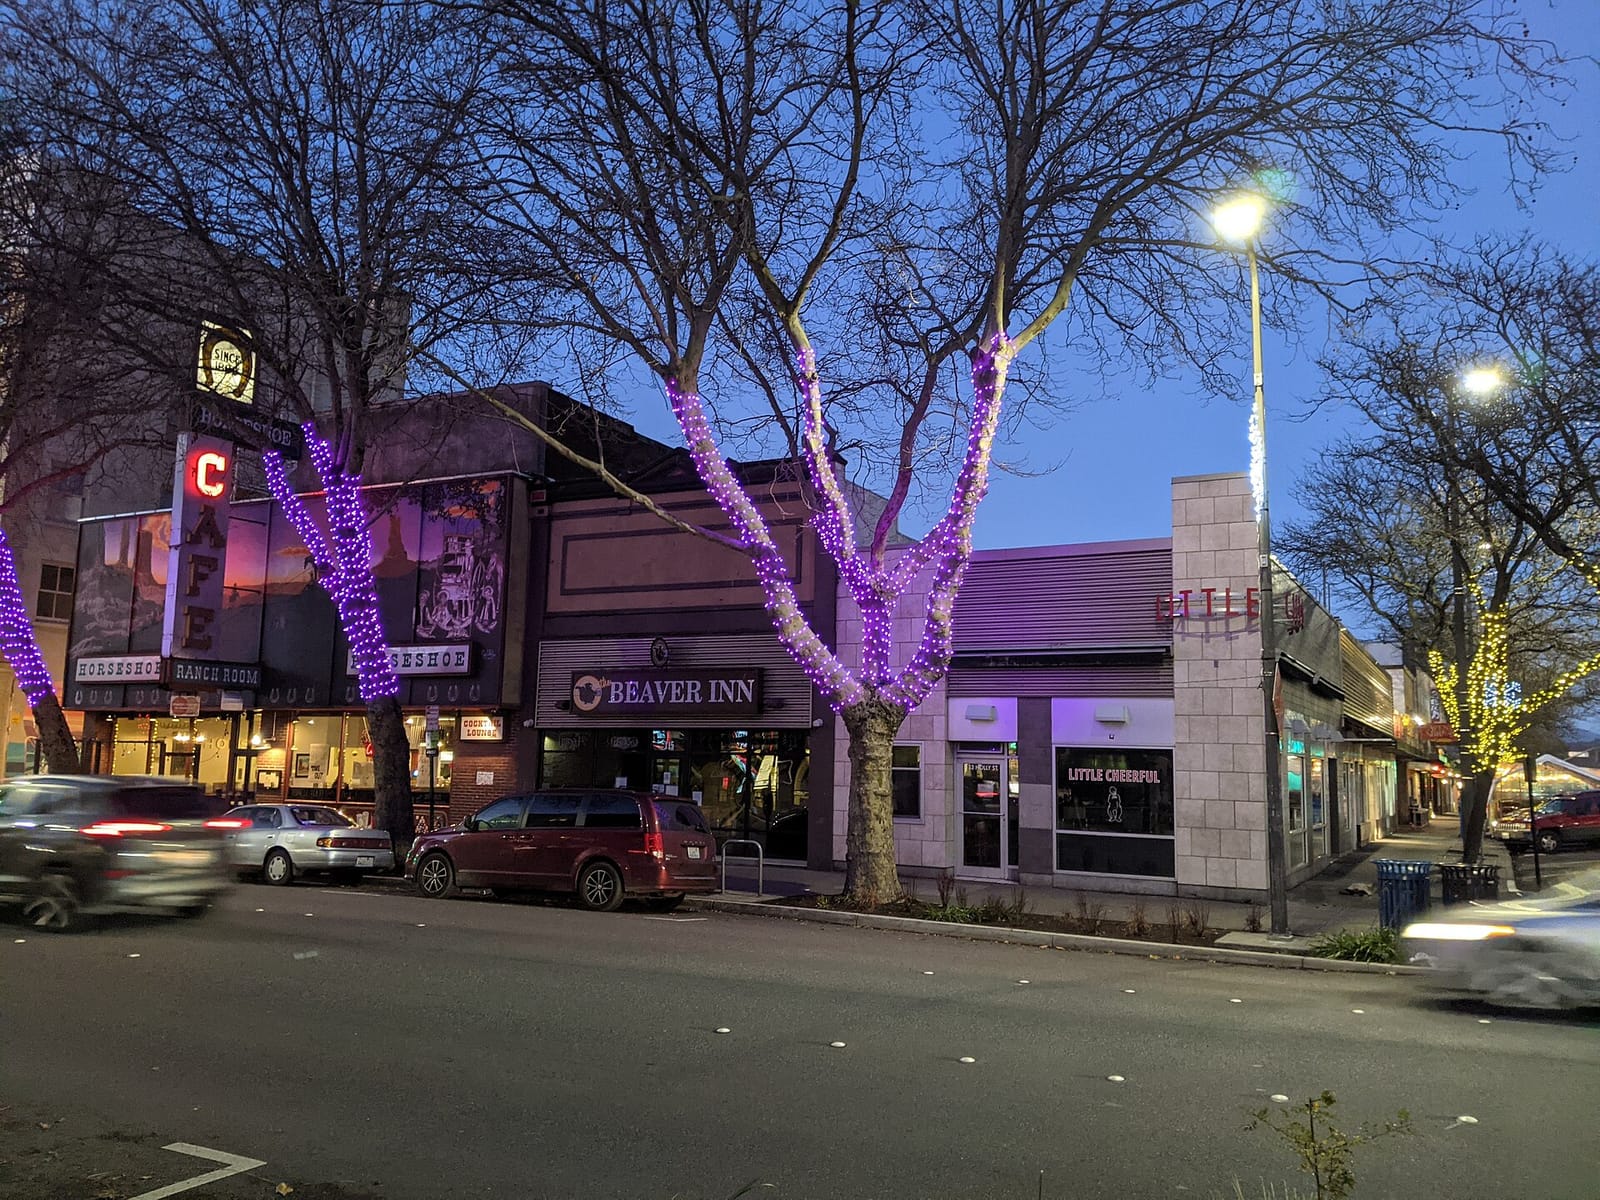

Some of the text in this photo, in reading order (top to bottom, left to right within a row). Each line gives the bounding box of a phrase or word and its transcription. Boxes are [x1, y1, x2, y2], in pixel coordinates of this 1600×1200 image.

[215, 348, 241, 363] SINCE
[181, 452, 226, 650] CAFE
[1156, 588, 1259, 621] LITTLE
[78, 661, 160, 676] HORSESHOE
[176, 664, 258, 684] RANCH ROOM
[608, 679, 754, 704] BEAVER INN
[466, 729, 497, 737] LOUNGE
[1068, 767, 1160, 783] LITTLE CHEERFUL
